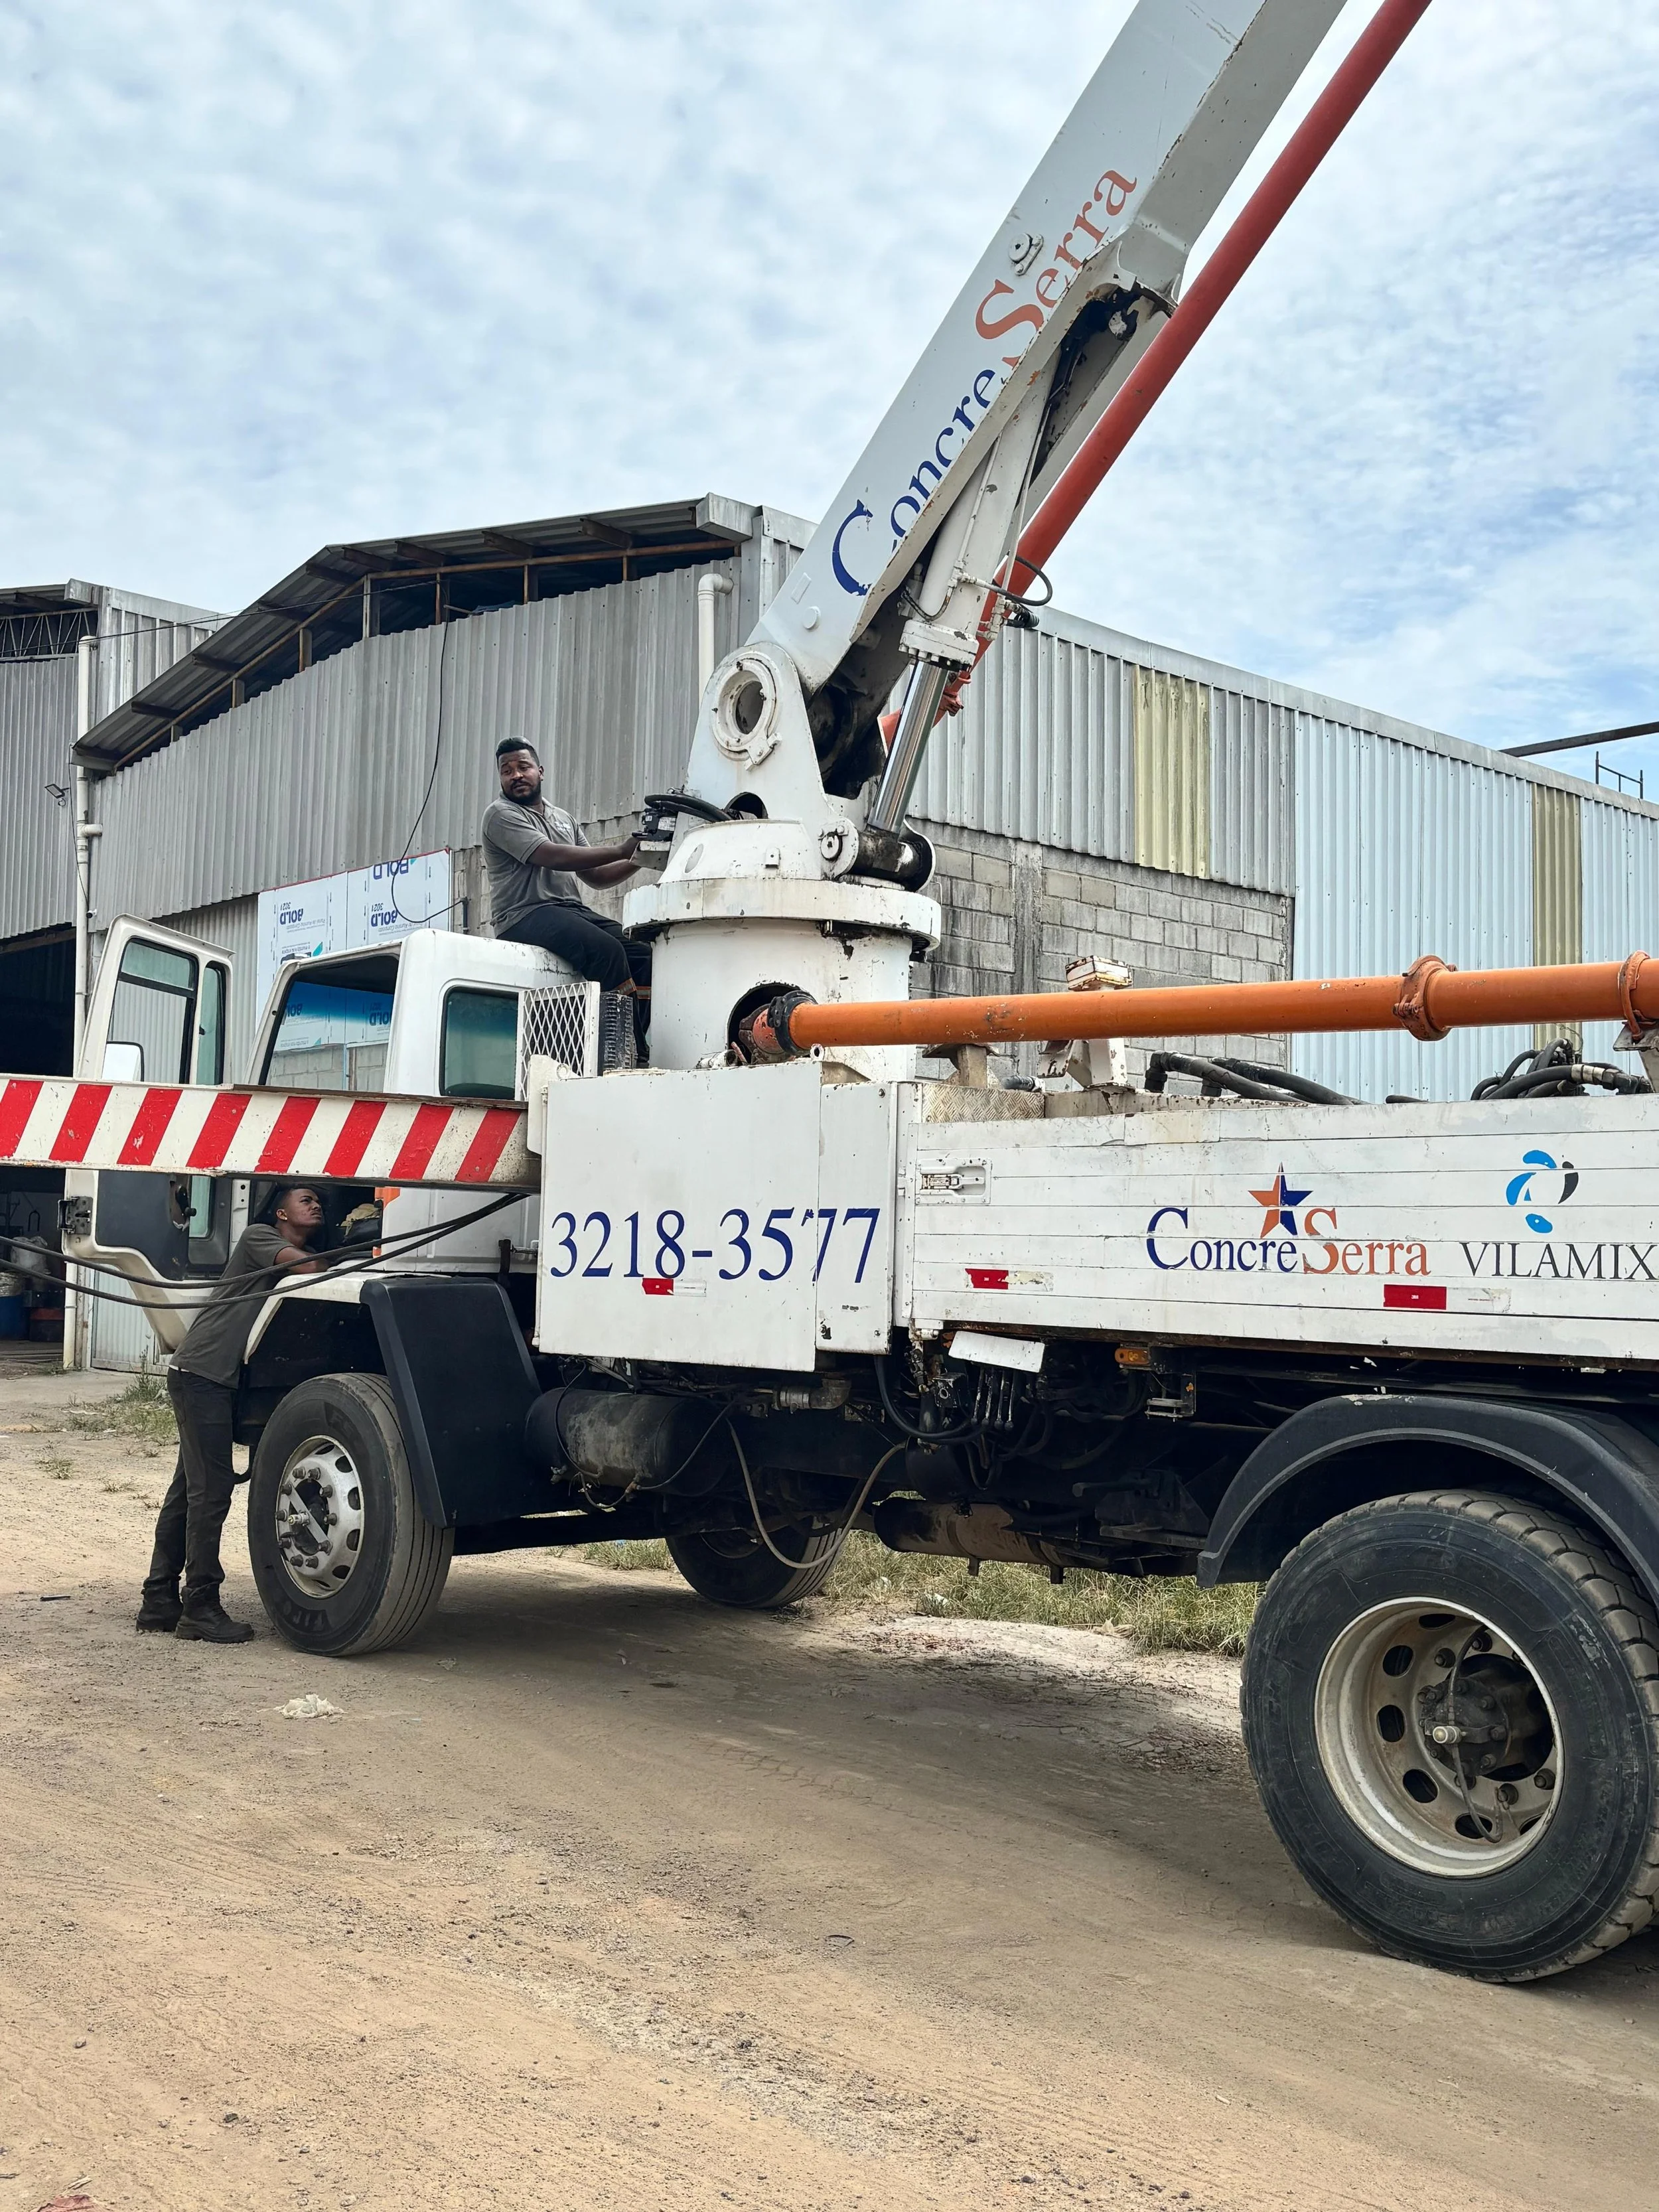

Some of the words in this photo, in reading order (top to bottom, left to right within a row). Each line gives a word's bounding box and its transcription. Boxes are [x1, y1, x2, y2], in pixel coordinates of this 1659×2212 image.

[279, 908, 304, 925] BOLD
[370, 909, 398, 927] BOLD
[550, 1207, 881, 1284] 3218-3577
[1459, 1242, 1659, 1281] VILAMIX
